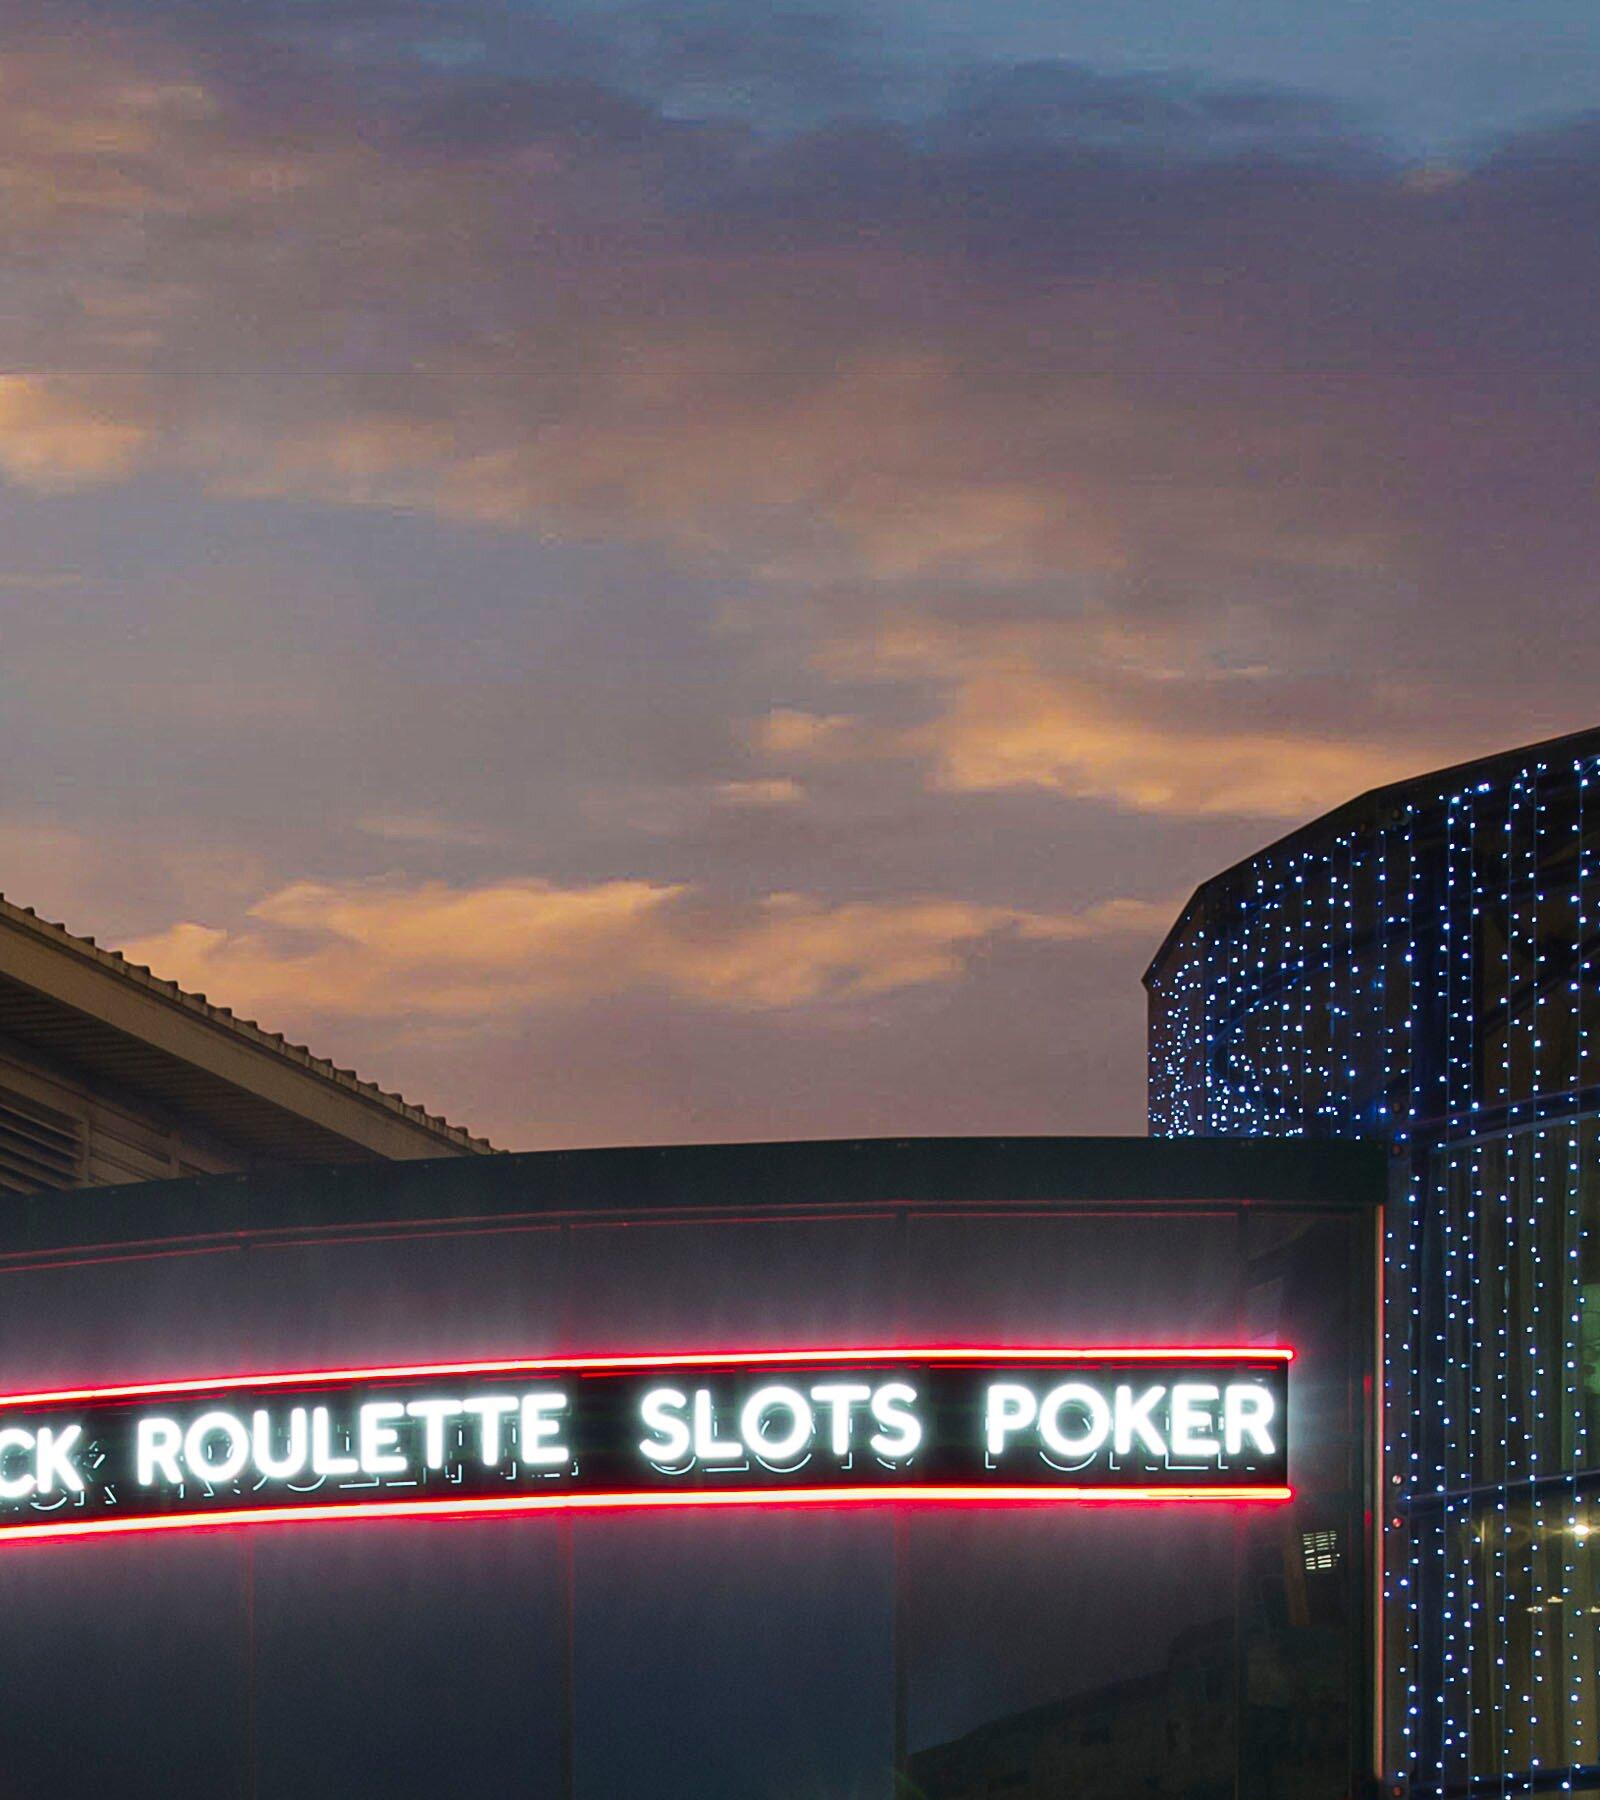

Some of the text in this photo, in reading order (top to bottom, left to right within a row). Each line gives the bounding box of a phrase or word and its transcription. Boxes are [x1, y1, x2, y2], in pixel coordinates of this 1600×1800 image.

[136, 1393, 570, 1487] ROULETTE
[638, 1384, 923, 1462] SLOTS
[983, 1382, 1277, 1457] POKER
